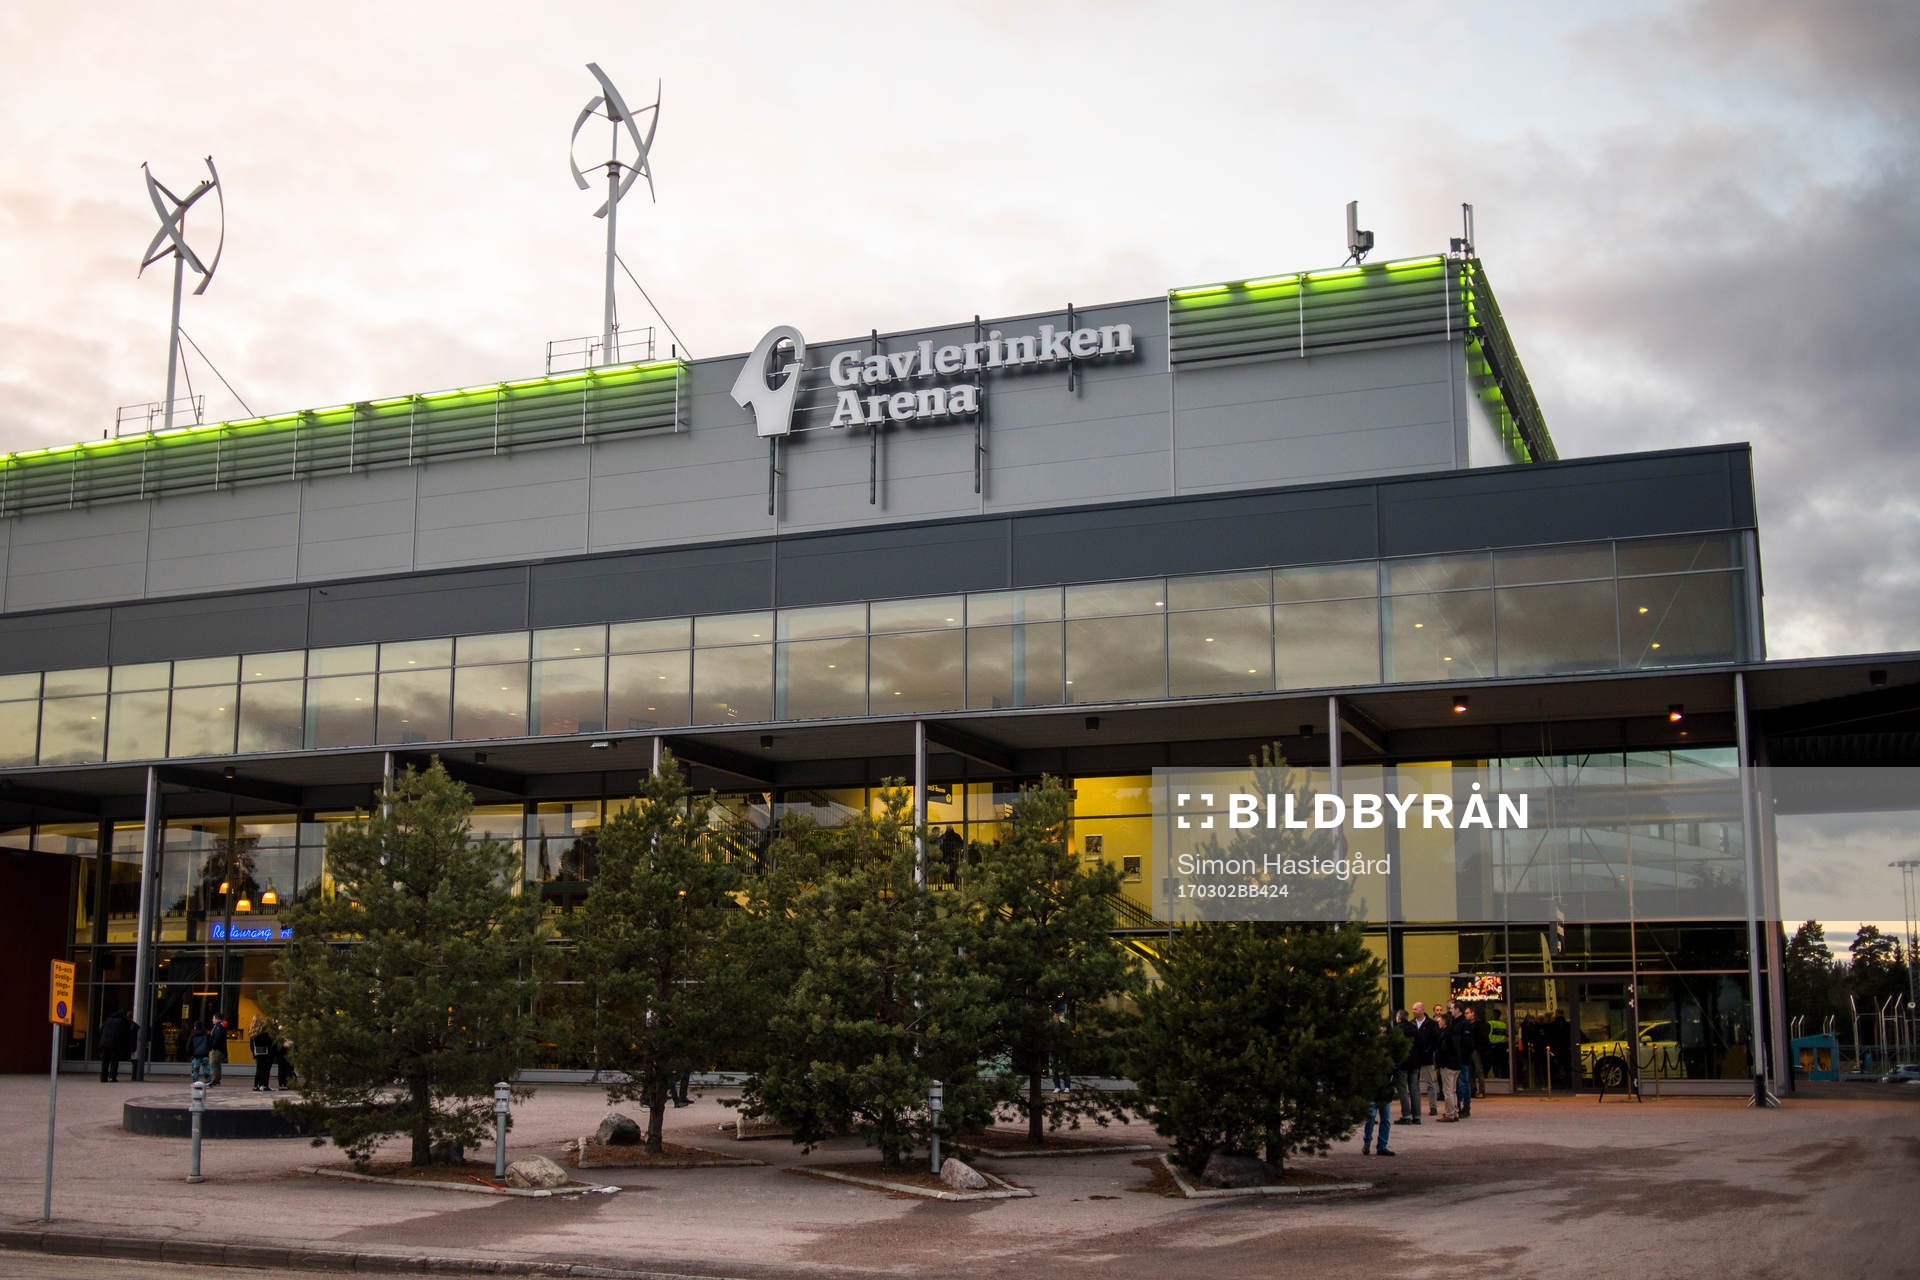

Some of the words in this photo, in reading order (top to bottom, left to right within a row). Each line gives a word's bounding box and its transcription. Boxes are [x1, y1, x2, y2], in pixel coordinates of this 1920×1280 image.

[830, 323, 1134, 387] Gavlerinken
[831, 384, 979, 428] Arena
[212, 924, 272, 941] Retaurang
